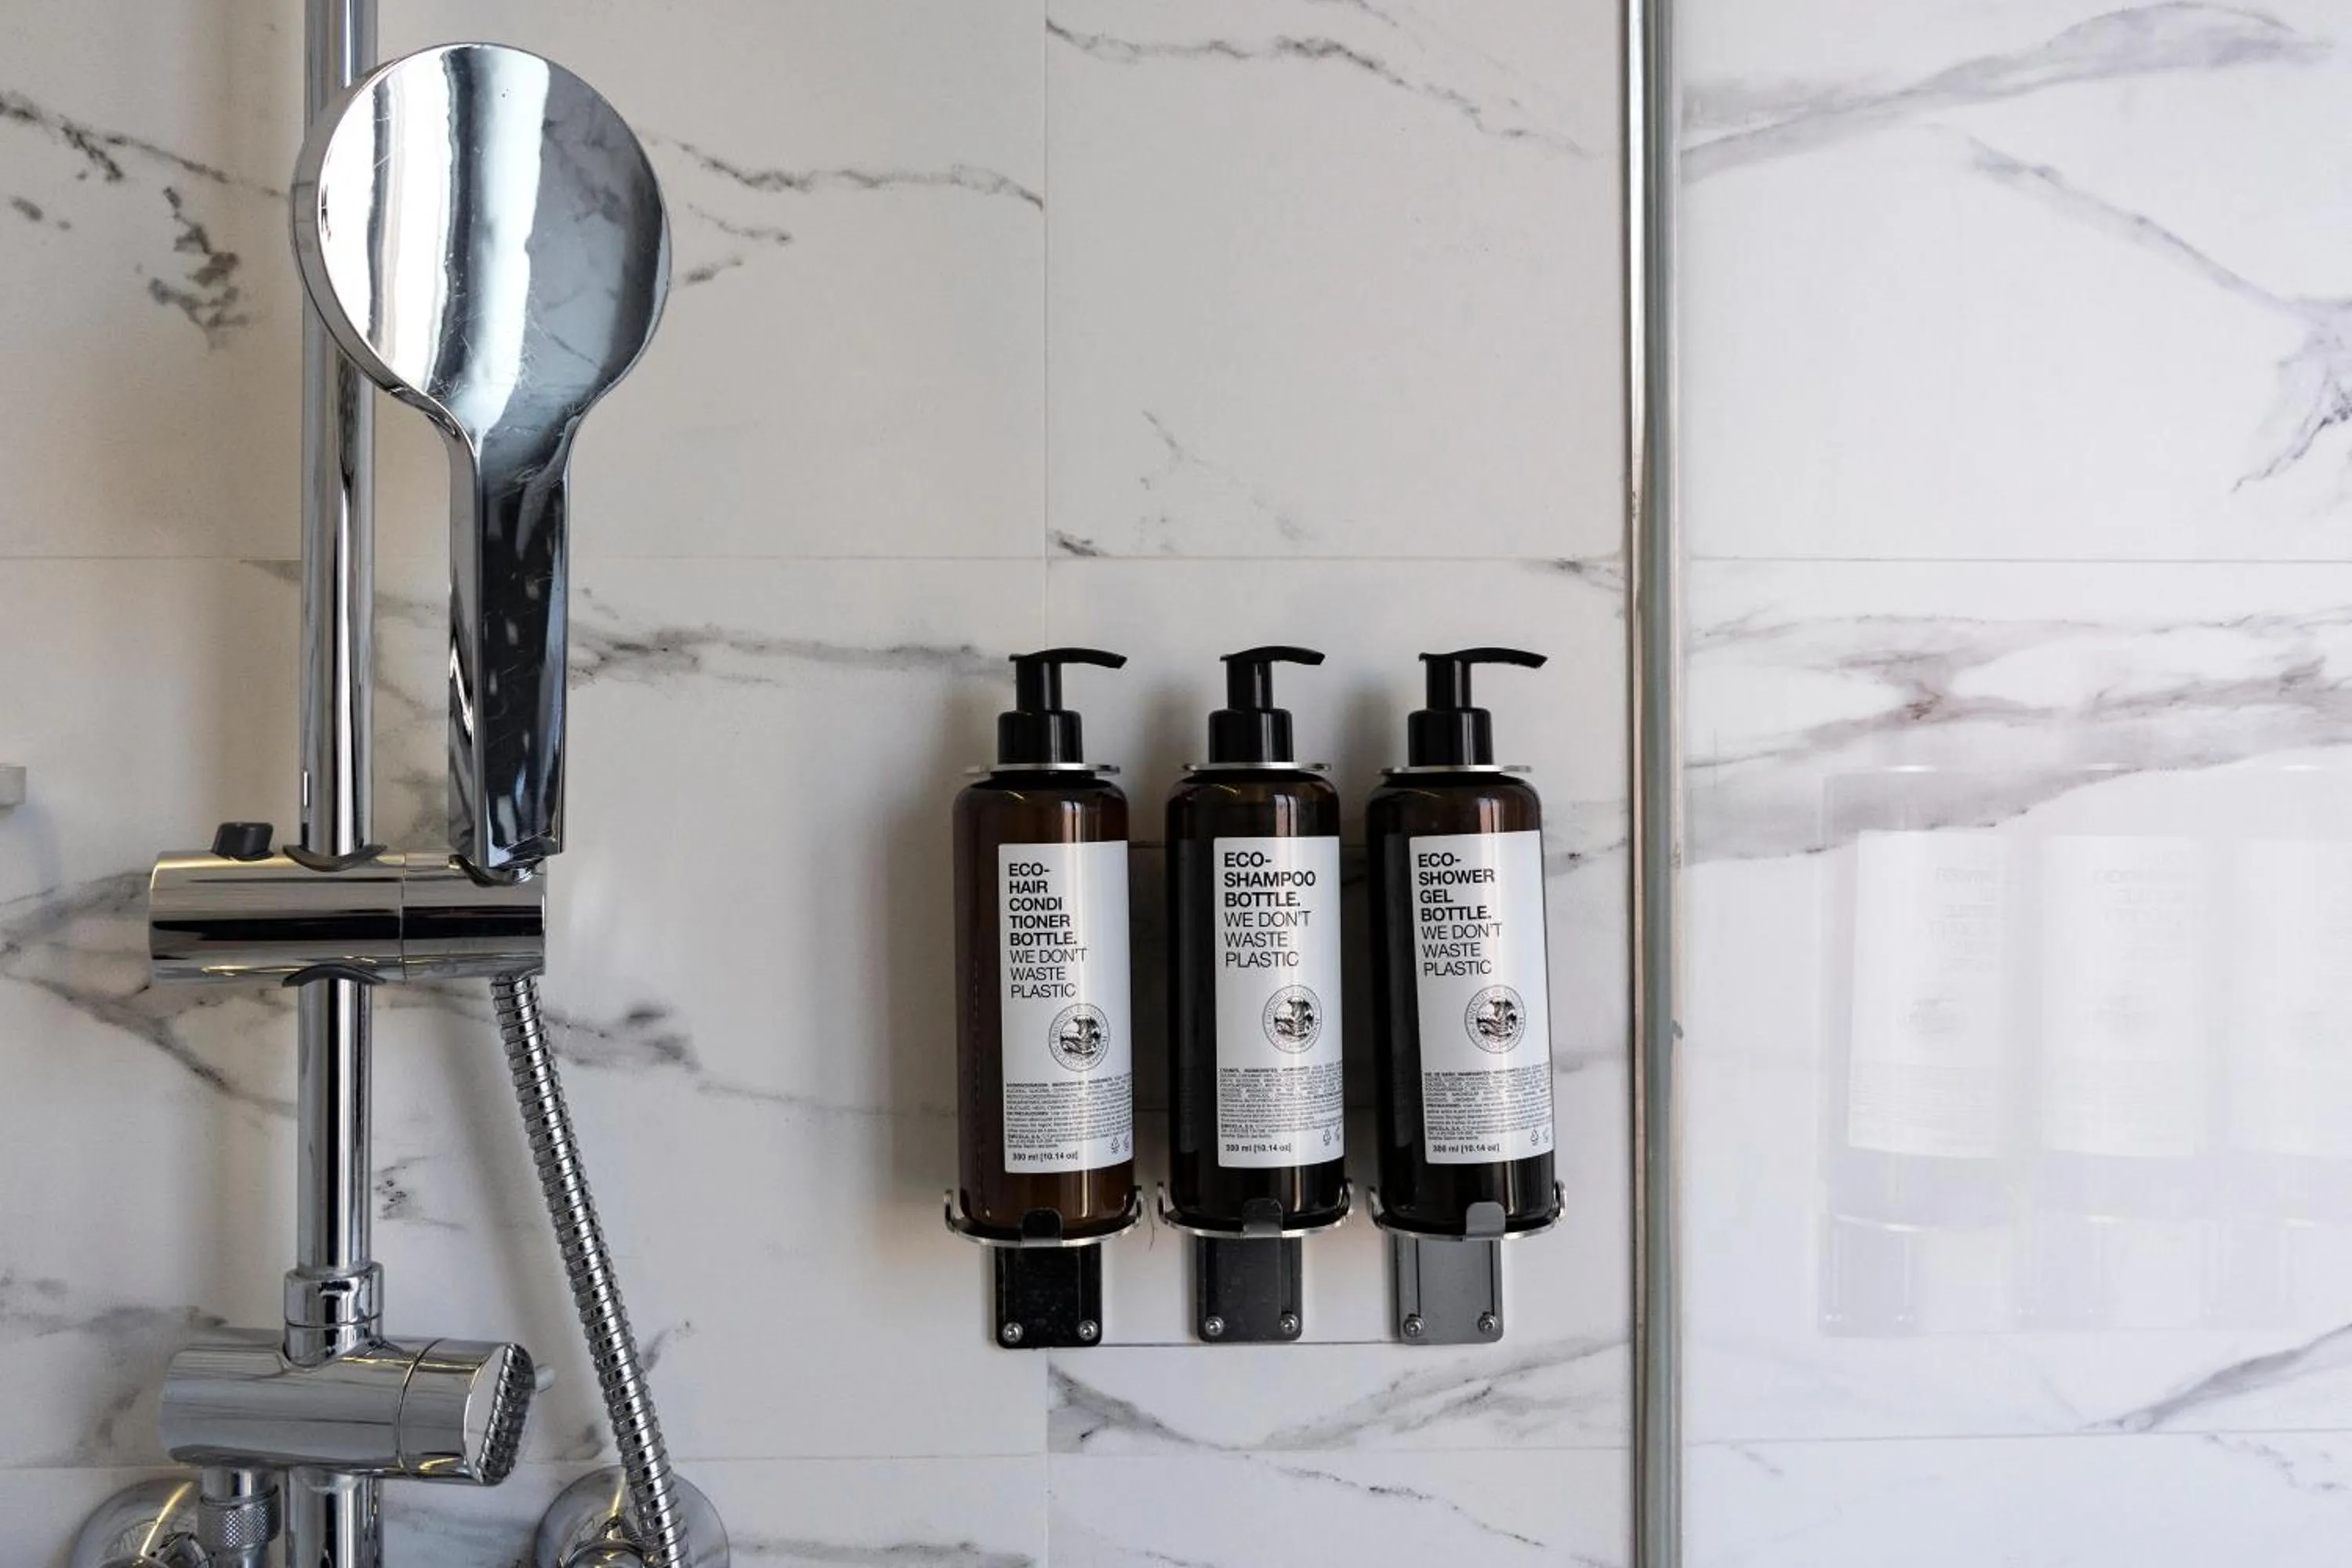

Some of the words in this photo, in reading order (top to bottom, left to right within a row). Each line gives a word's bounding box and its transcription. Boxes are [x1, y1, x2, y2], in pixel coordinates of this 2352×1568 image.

[1224, 851, 1272, 868] ECO-
[1417, 852, 1461, 868] ECO-
[1008, 862, 1050, 877] ECO-
[1418, 869, 1495, 885] SHOWER
[1009, 880, 1048, 894] HAIR
[1224, 871, 1316, 887] SHAMPOO
[1009, 897, 1062, 911] CONDI
[1225, 891, 1301, 907] BOTTLE.
[1420, 889, 1454, 904] GEL
[1009, 914, 1070, 928] TIONER
[1224, 912, 1254, 927] WE
[1258, 910, 1312, 927] DON'T
[1421, 906, 1491, 922] BOTTLE.
[1010, 931, 1077, 946] BOTTLE.
[1421, 925, 1447, 940] WE
[1452, 922, 1503, 939] DON'T
[1224, 931, 1288, 948] WASTE
[1010, 949, 1035, 964] WE
[1040, 948, 1087, 964] DON'T
[1422, 942, 1481, 958] WASTE
[1225, 951, 1298, 968] PLASTIC
[1011, 967, 1065, 980] WASTE
[1424, 960, 1492, 976] PLASTIC
[1011, 983, 1076, 998] PLASTIC
[1241, 1143, 1252, 1152] ml
[1448, 1144, 1458, 1152] ml
[1028, 1152, 1038, 1161] ml
